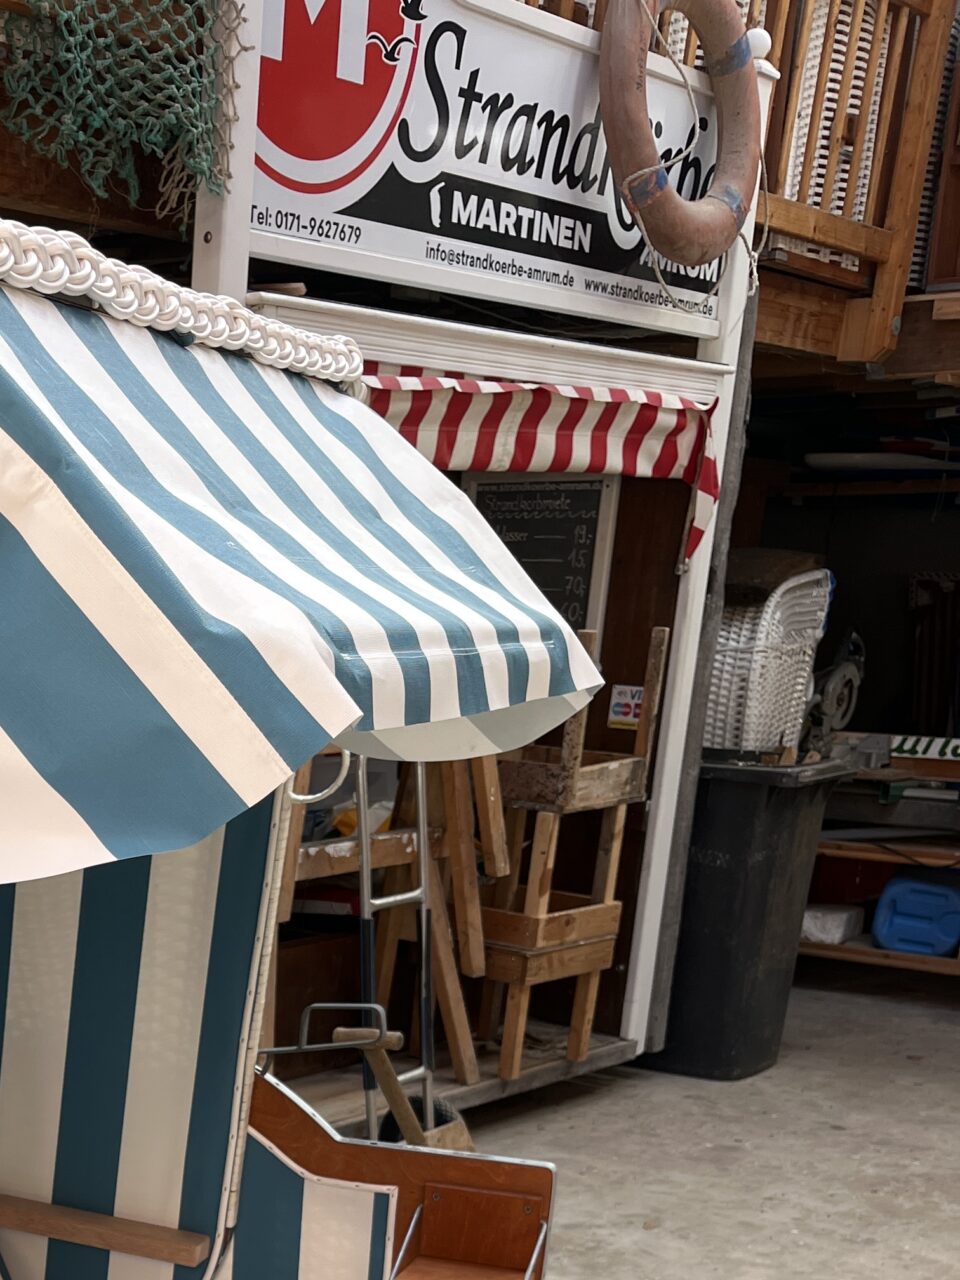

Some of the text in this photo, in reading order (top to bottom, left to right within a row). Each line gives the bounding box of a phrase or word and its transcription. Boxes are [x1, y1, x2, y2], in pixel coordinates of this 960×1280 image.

[397, 21, 716, 232] Strandrb
[249, 204, 362, 244] Tel: 0171-9627679
[451, 190, 592, 253] MARTINEN
[425, 241, 575, 287] info@strandkoerbe-amrum.de
